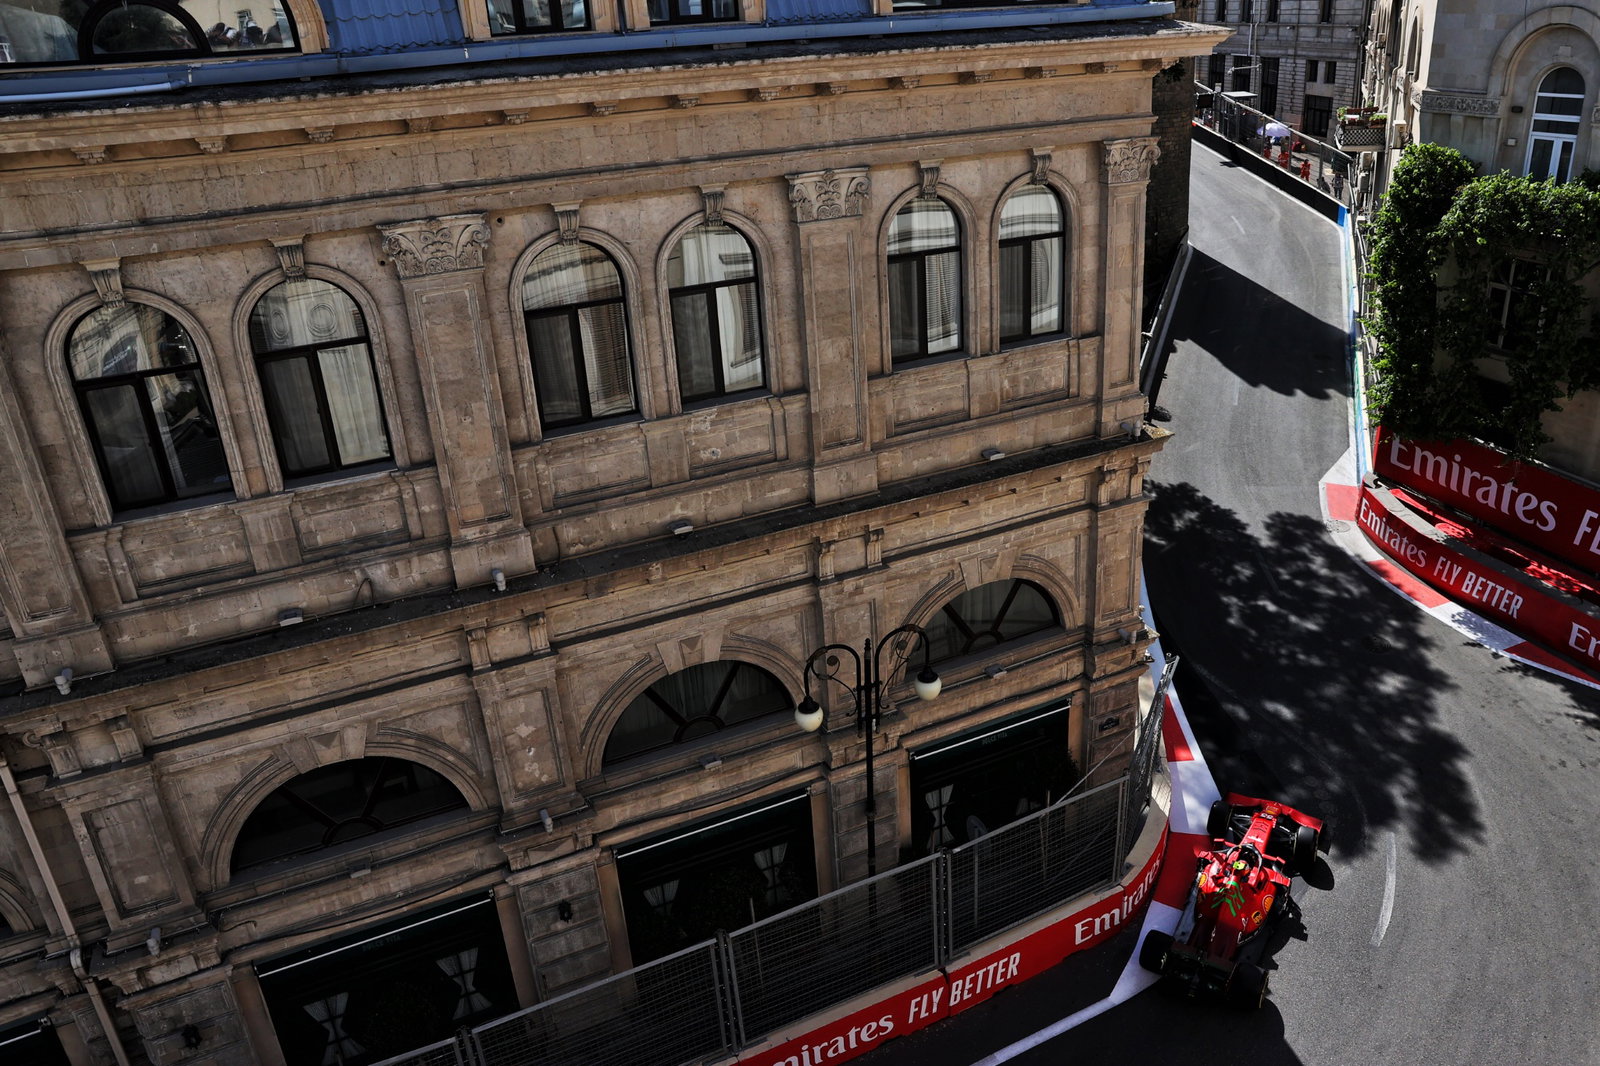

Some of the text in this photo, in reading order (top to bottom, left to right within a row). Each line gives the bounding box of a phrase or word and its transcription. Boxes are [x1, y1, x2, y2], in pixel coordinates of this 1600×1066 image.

[1390, 432, 1558, 532] Emirates
[1359, 497, 1524, 620] Emirates FLY BETTER
[1074, 853, 1161, 946] Emirates
[908, 986, 945, 1024] FLY
[949, 951, 1021, 1008] BETTER
